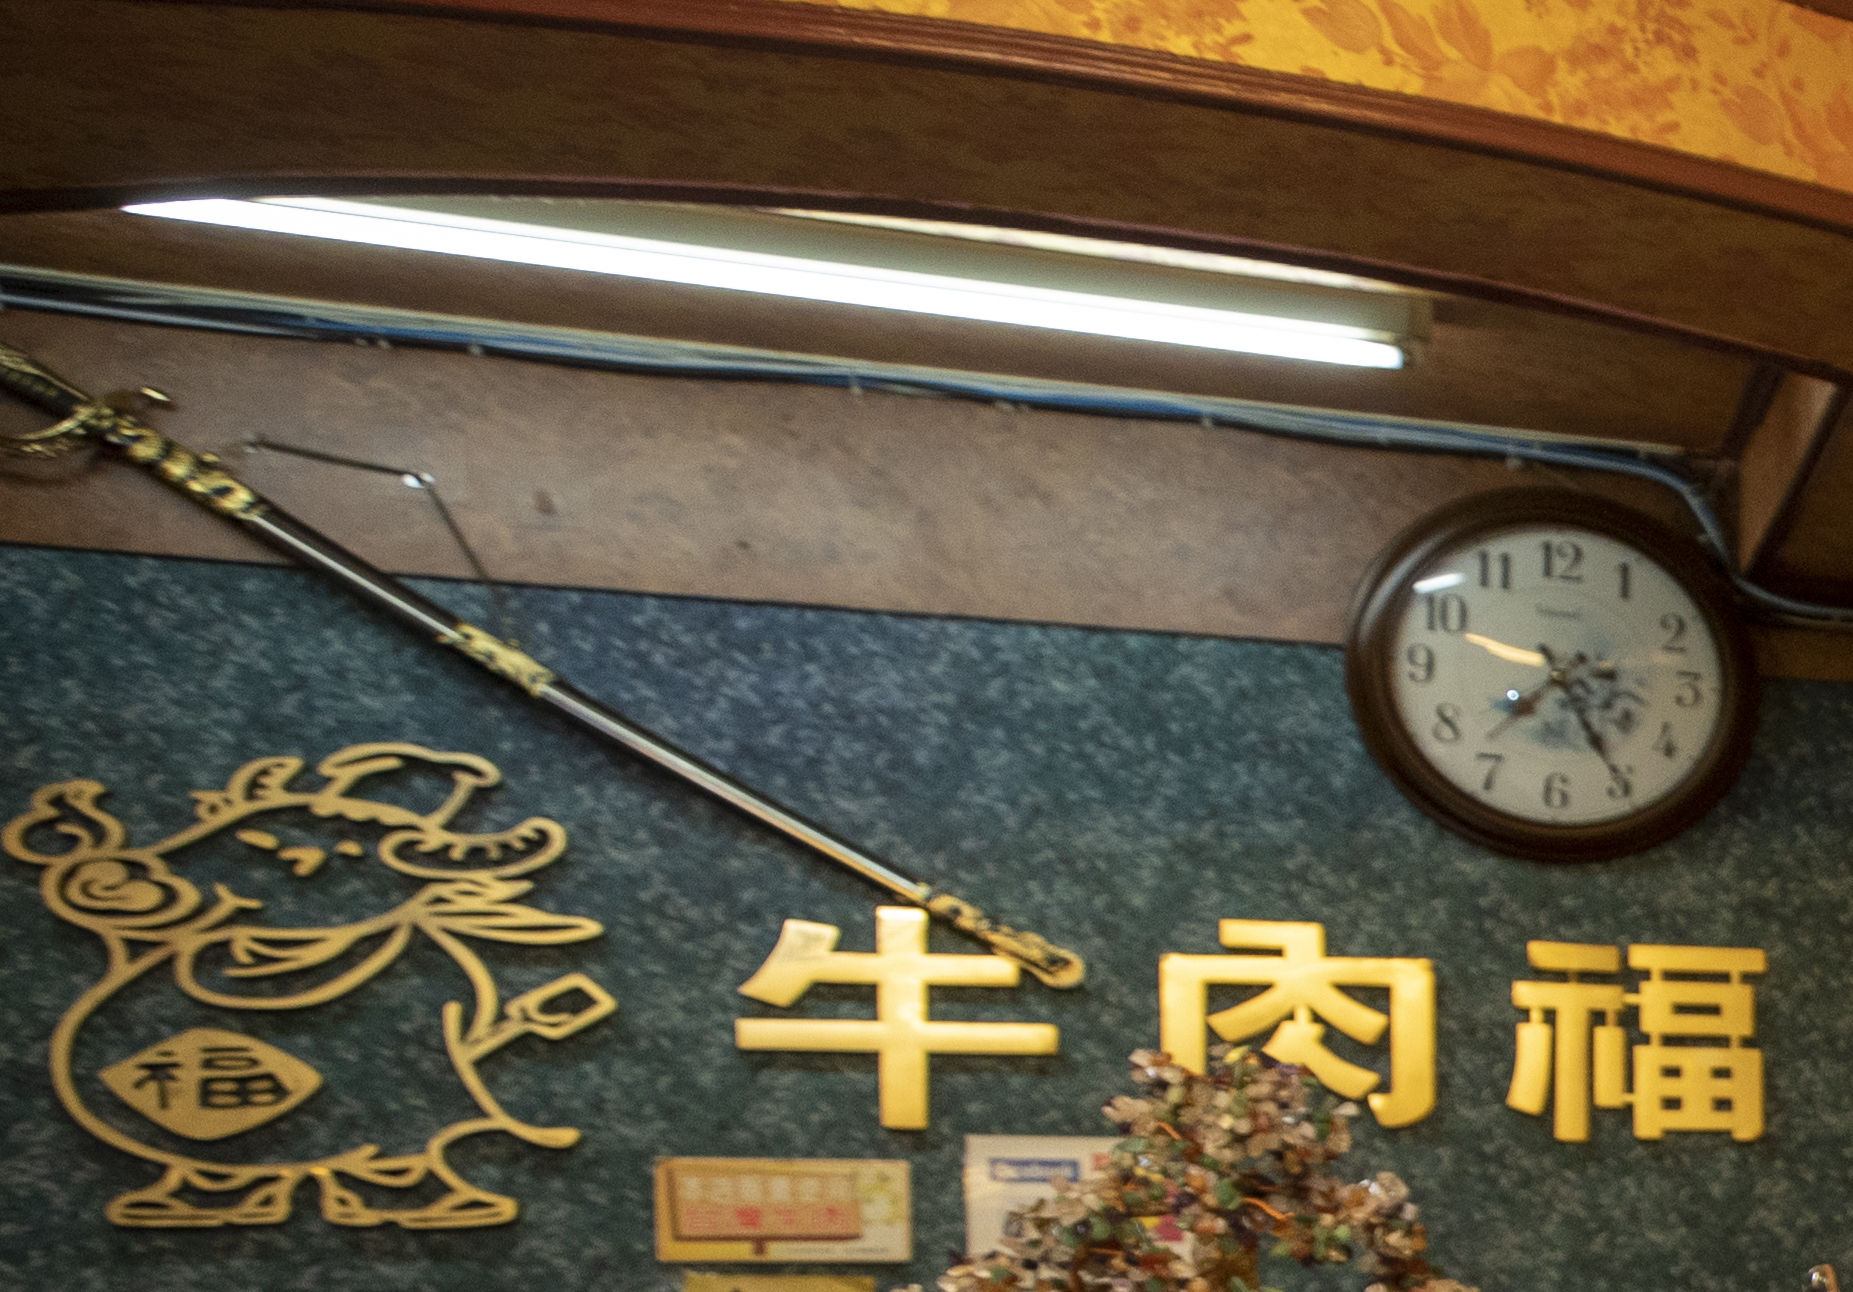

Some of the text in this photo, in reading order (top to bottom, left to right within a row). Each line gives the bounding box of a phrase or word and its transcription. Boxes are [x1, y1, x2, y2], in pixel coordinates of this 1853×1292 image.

[1478, 550, 1512, 591] 11
[1539, 540, 1583, 583] 12
[1617, 562, 1632, 599] 1
[1426, 593, 1466, 633] 10
[1659, 612, 1687, 652] 2
[1407, 644, 1434, 683] 9
[1675, 671, 1701, 708] 3
[1433, 704, 1462, 744] 8
[1653, 722, 1677, 759] 4
[1476, 753, 1504, 791] 7
[1542, 773, 1569, 808] 6
[1607, 764, 1632, 798] 5
[735, 906, 1765, 1141] 牛肉福
[132, 1048, 293, 1109] 福
